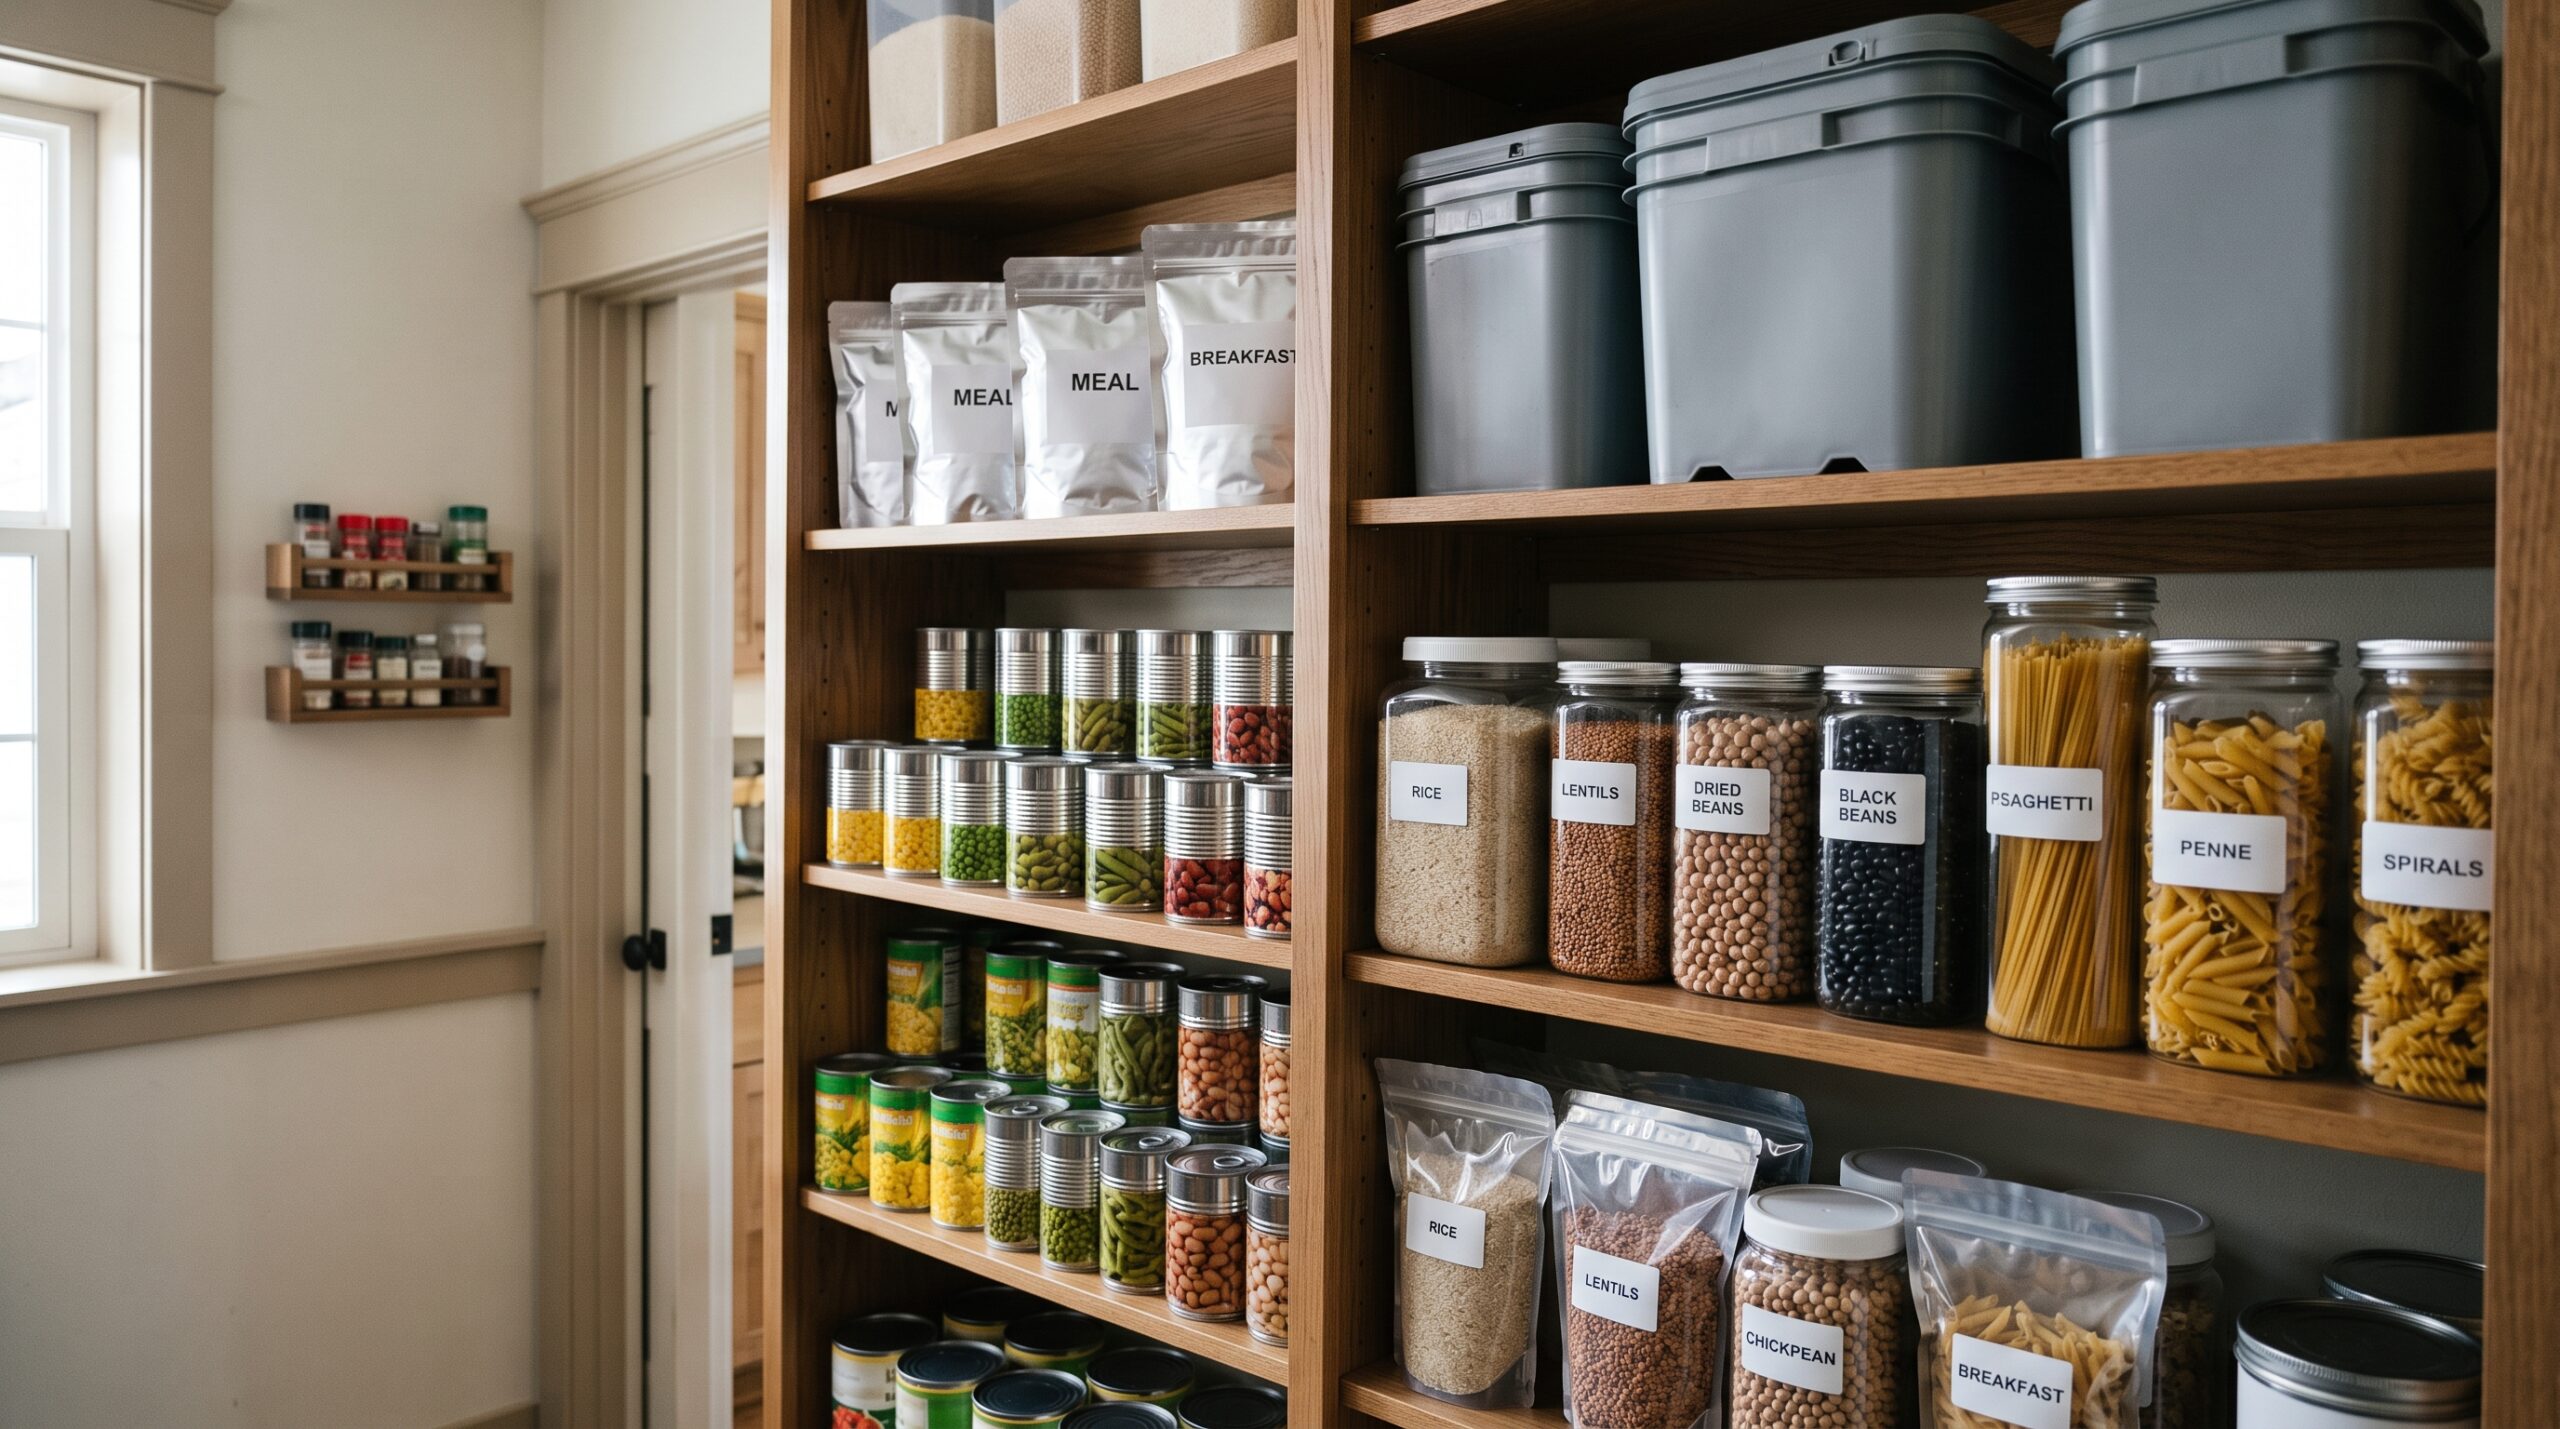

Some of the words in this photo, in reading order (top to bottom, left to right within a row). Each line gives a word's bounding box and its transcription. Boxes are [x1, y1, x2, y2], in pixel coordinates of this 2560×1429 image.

[1190, 348, 1296, 367] BREAKFAST
[1071, 372, 1140, 393] MEAL
[953, 388, 1013, 406] MEAL
[1411, 784, 1443, 801] RICE
[1561, 782, 1620, 801] LENTILS
[1693, 780, 1743, 798] DRIED
[1839, 787, 1897, 806] BLACK
[1691, 798, 1745, 817] BEANS
[1990, 790, 2094, 812] PSAGHETTI
[1839, 806, 1898, 825] BEANS
[2180, 839, 2253, 861] PENNE
[2383, 853, 2484, 879] SPIRALS
[1428, 1219, 1458, 1239] RICE
[1584, 1272, 1640, 1301] LENTILS
[1745, 1330, 1837, 1366] CHICKPEAN
[1958, 1362, 2065, 1405] BREAKFAST
